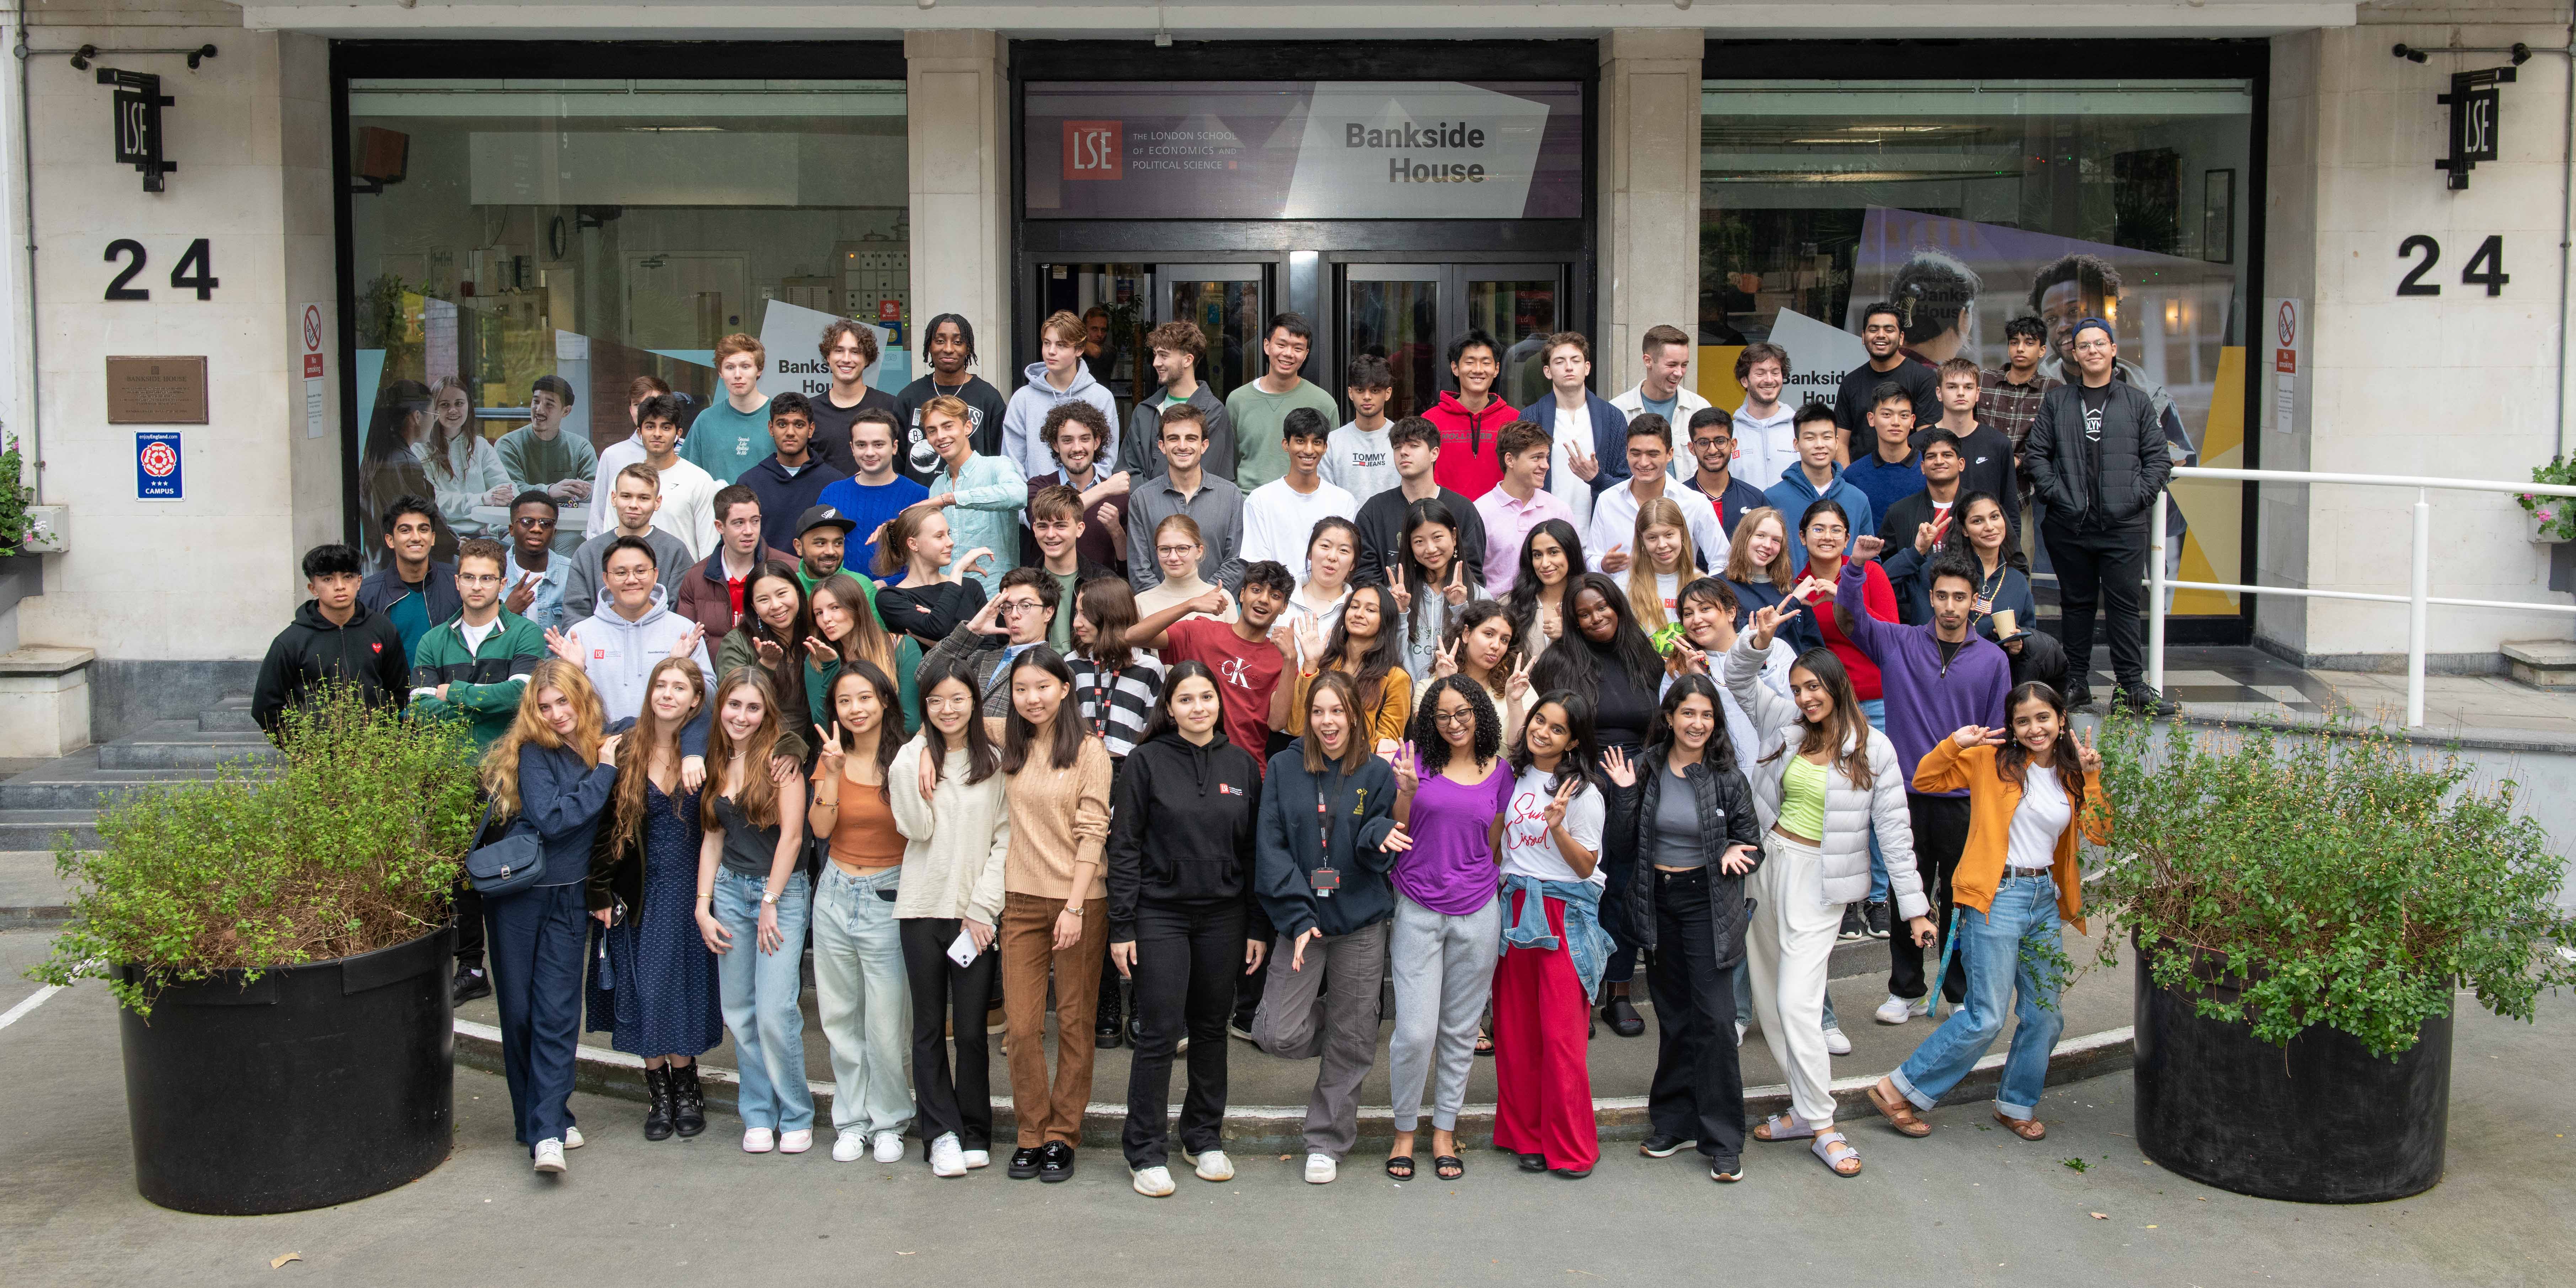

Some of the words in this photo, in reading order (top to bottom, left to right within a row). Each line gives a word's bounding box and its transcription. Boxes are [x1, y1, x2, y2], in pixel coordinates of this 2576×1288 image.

[124, 101, 147, 155] LSE
[2465, 99, 2489, 153] LSE
[1151, 132, 1193, 140] LONDON
[1197, 132, 1237, 140] SCHOOL
[1346, 122, 1485, 148] Bankside
[1074, 132, 1112, 169] LSE
[1149, 146, 1214, 155] ECONOMICS
[1133, 161, 1181, 169] POLITICAL
[1184, 161, 1222, 169] SCIENCE
[1390, 158, 1485, 183] House
[779, 359, 833, 373] Banks
[2279, 361, 2293, 370] smoking
[1783, 370, 1845, 385] Banksid
[803, 379, 833, 393] Hou
[1803, 391, 1836, 405] Hou
[913, 431, 918, 441] B
[1441, 432, 1492, 440] HOLLIER
[1352, 453, 1386, 461] TOMMY
[1217, 661, 1234, 672] Calvin
[1245, 671, 1261, 681] Jeans
